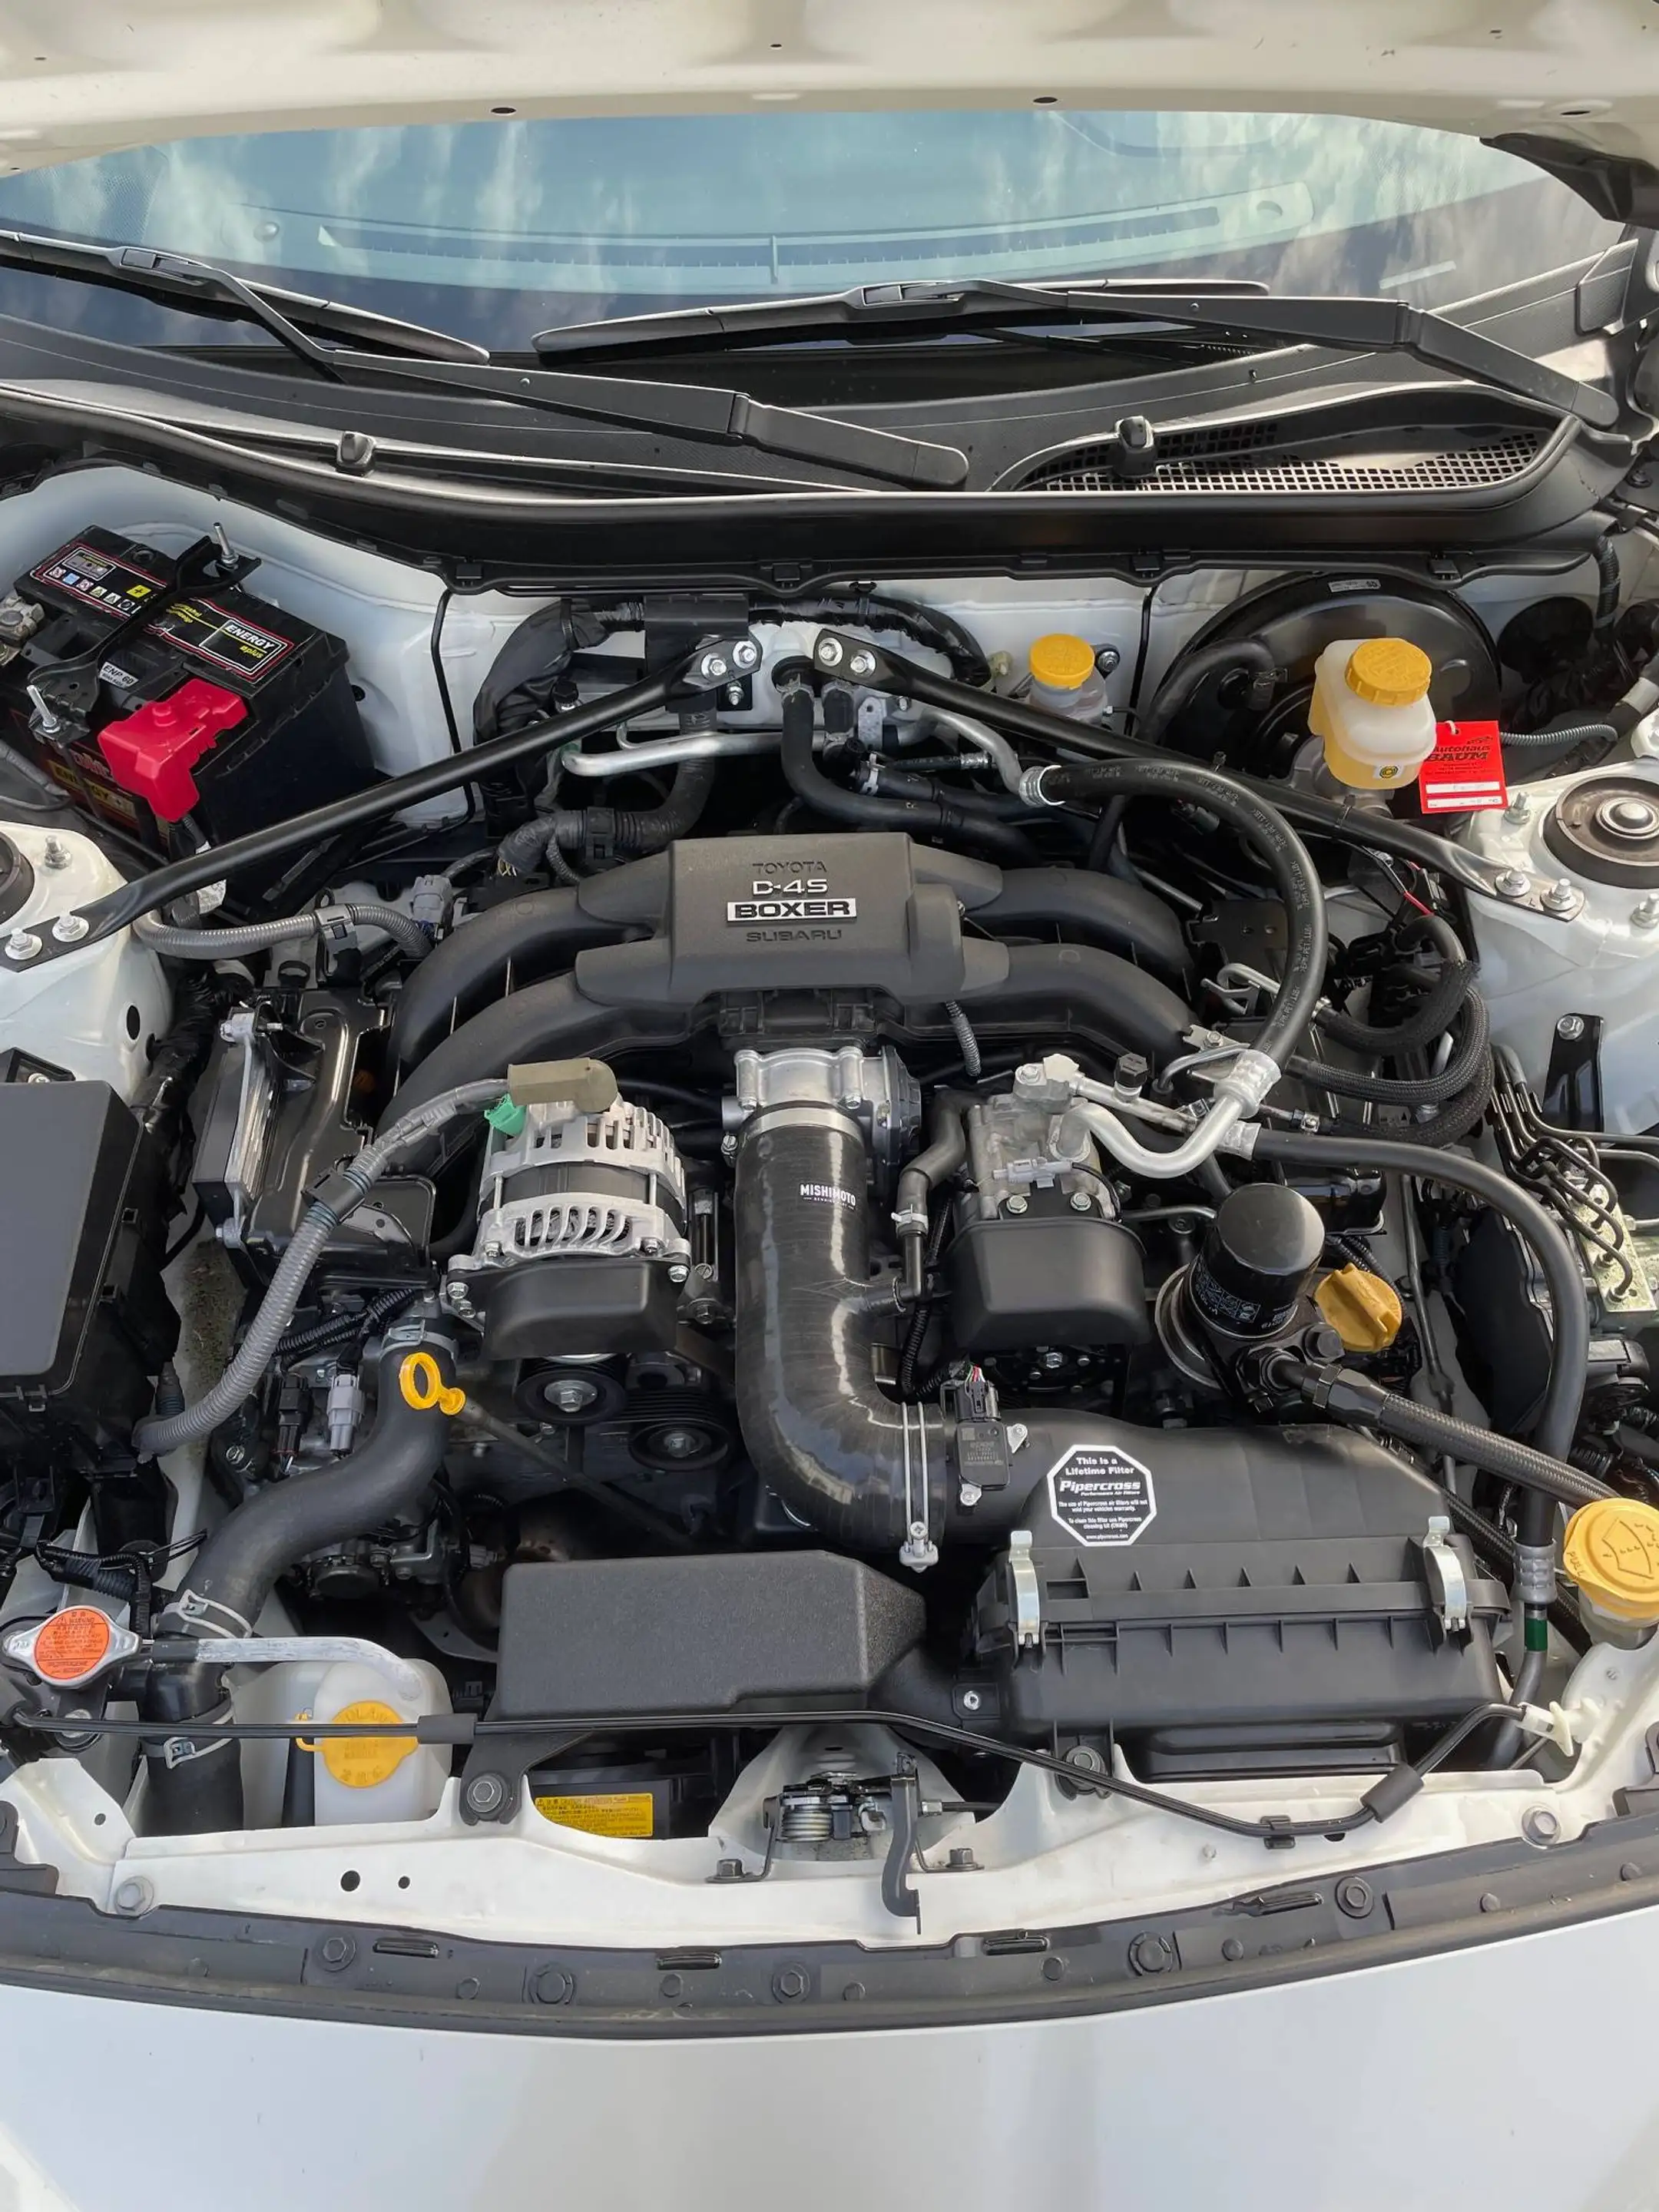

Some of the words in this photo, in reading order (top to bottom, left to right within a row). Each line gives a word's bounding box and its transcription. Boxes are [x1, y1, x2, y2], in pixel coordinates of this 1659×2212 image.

[224, 624, 275, 649] ENERGY
[103, 664, 123, 677] ENP
[1428, 752, 1489, 762] BAUM
[752, 861, 827, 874] TOYOTA
[753, 879, 828, 896] D-4S
[734, 901, 850, 919] BOXER
[747, 929, 842, 942] SUBARU
[800, 1184, 856, 1206] MISHIMOTO
[1060, 1480, 1141, 1493] Pipercross
